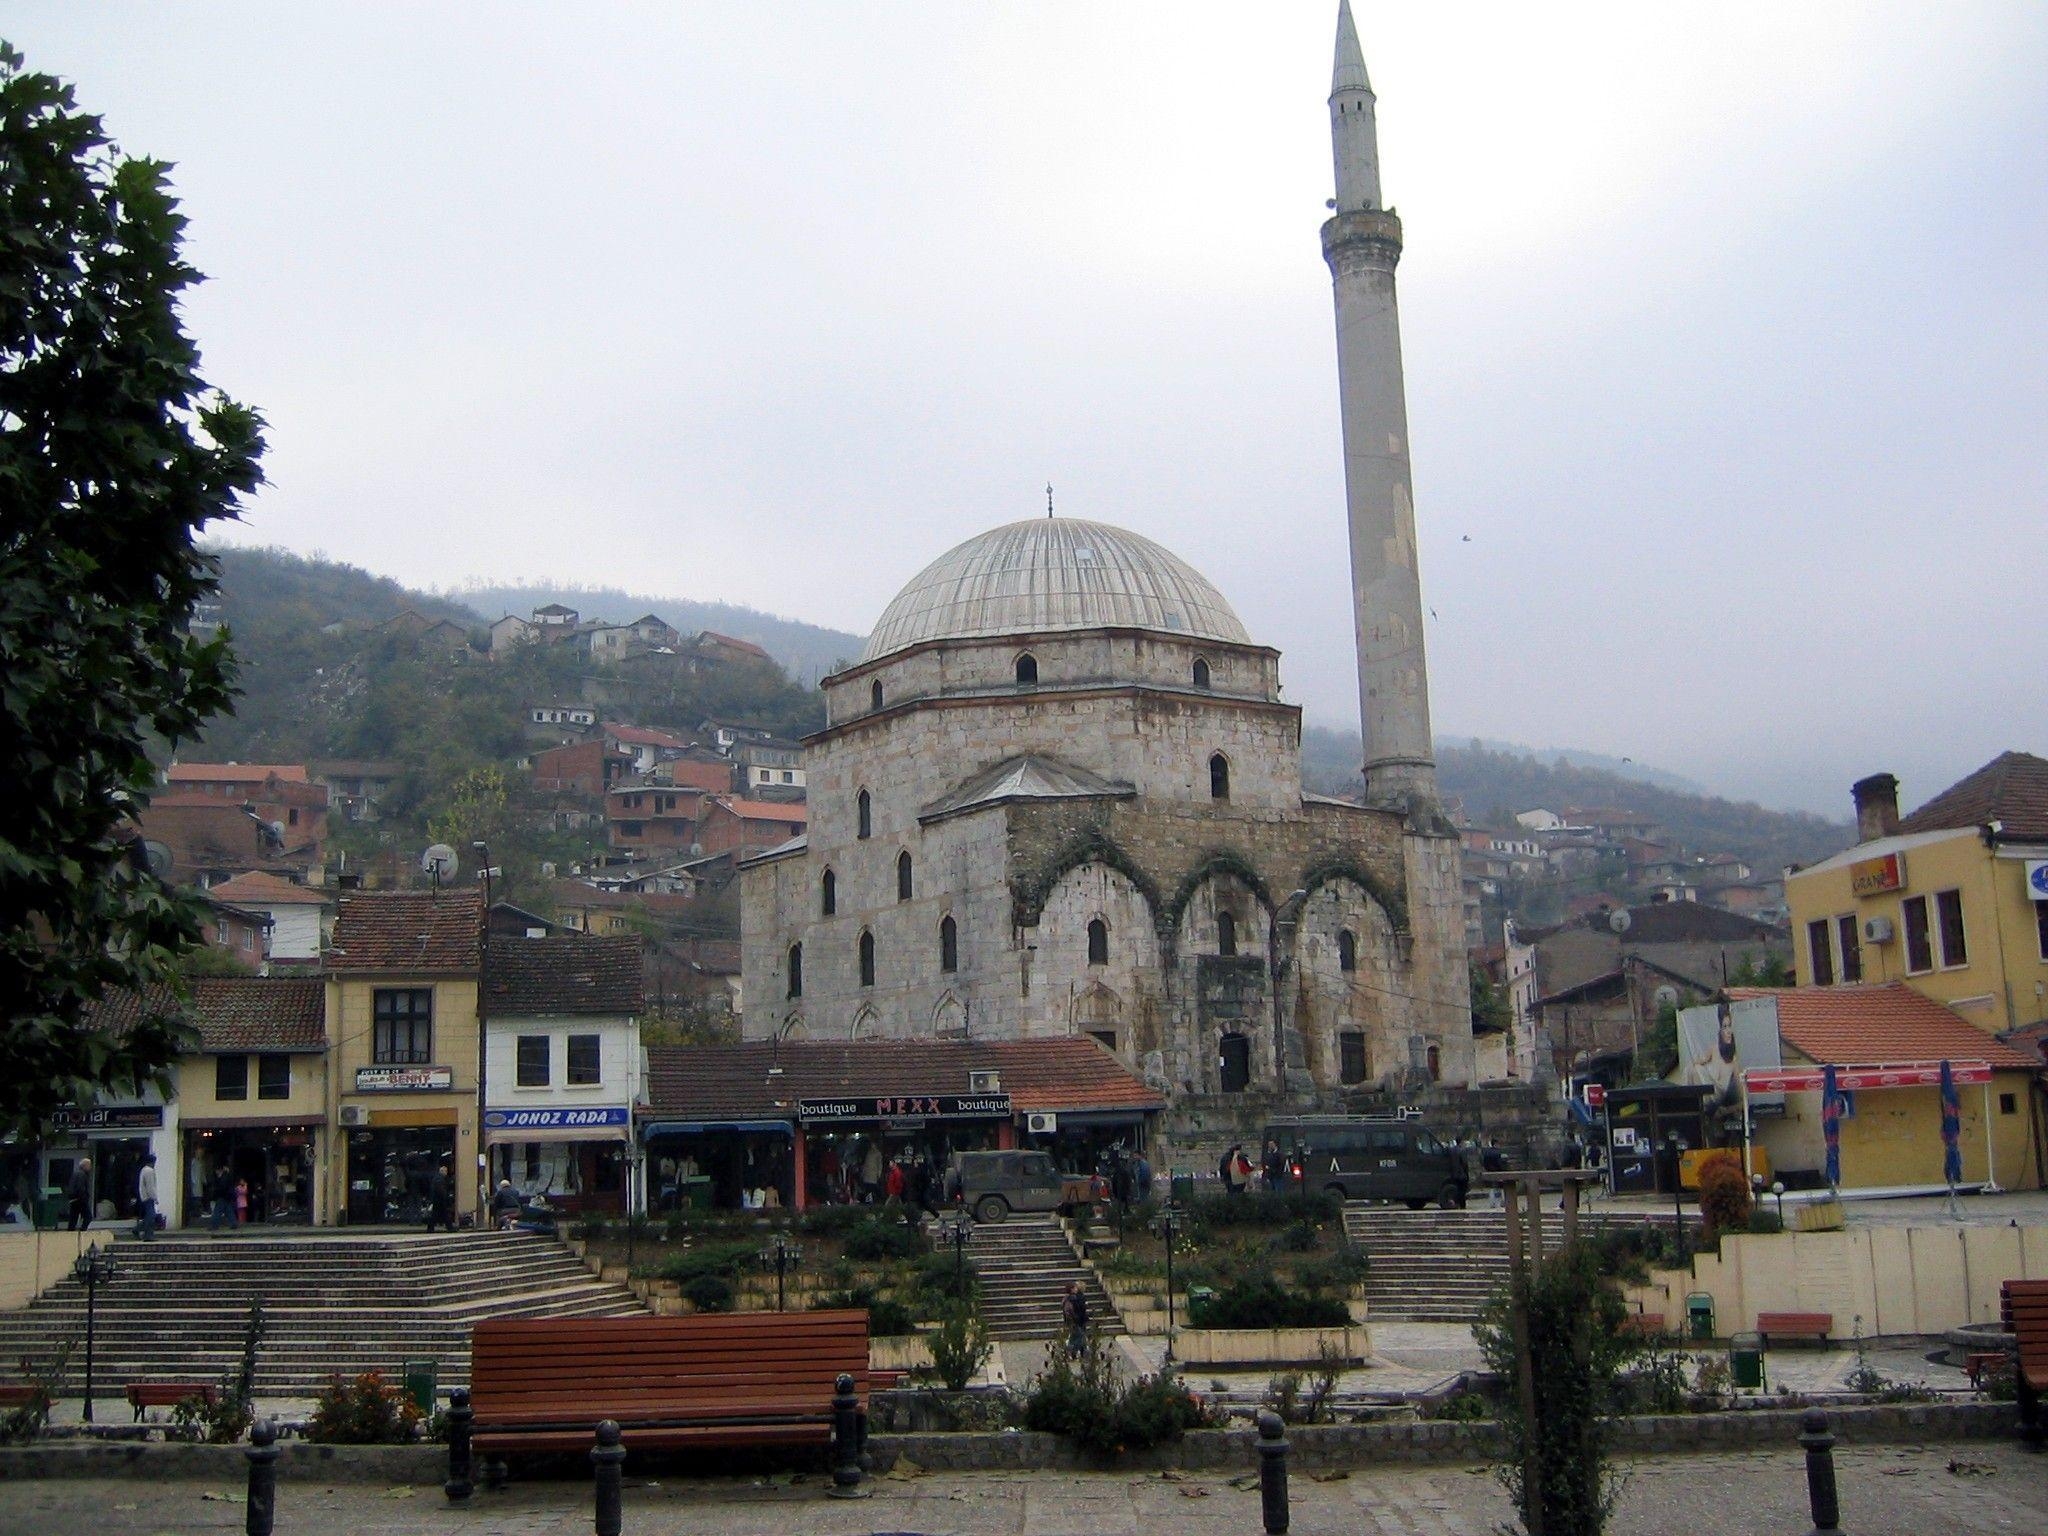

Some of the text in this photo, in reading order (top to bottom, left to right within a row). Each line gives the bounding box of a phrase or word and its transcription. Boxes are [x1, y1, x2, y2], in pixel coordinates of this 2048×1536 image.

[801, 1098, 1010, 1115] boutique MEXX boutique
[566, 1111, 608, 1124] RADA
